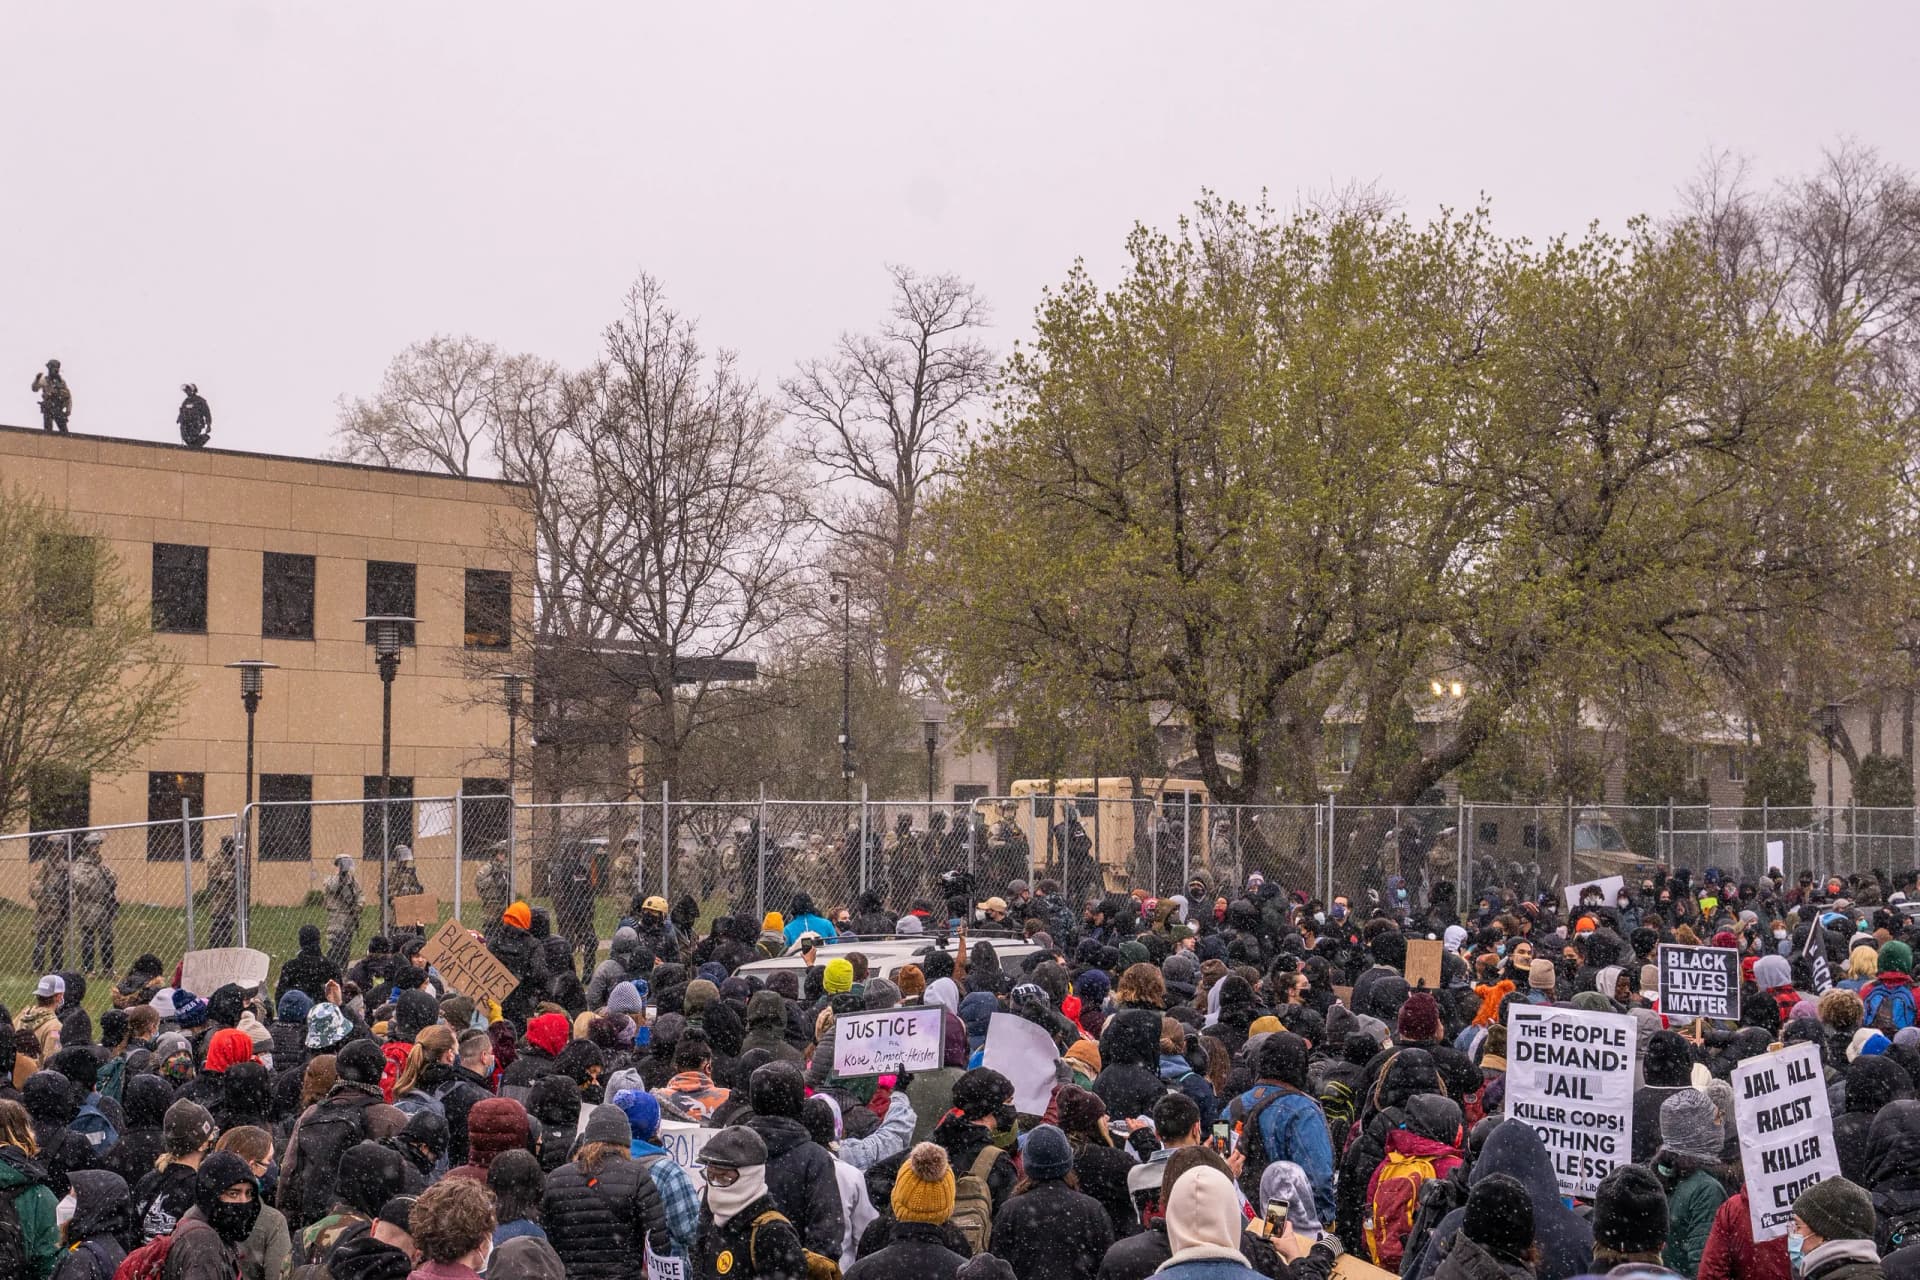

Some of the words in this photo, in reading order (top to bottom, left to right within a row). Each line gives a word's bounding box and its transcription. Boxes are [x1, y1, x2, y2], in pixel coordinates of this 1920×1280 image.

[439, 925, 483, 970] BLACK
[472, 957, 513, 1000] LIVES
[1667, 951, 1726, 971] BLACK
[433, 951, 490, 1009] MATTER
[1669, 970, 1726, 992] LIVES
[1668, 994, 1728, 1015] MATTER
[846, 1018, 917, 1040] JUSTICE
[1520, 1024, 1547, 1038] THE
[1551, 1022, 1626, 1047] PEOPLE
[1516, 1041, 1628, 1071] DEMAND:
[1544, 1073, 1593, 1100] JAIL
[1744, 1069, 1780, 1099] JAIL
[1786, 1057, 1816, 1086] ALL
[1513, 1102, 1566, 1124] KILLER
[1570, 1110, 1624, 1132] COPS!
[1756, 1095, 1812, 1134] RACIST
[1530, 1125, 1615, 1154] OTHING
[1761, 1135, 1822, 1174] KILLER
